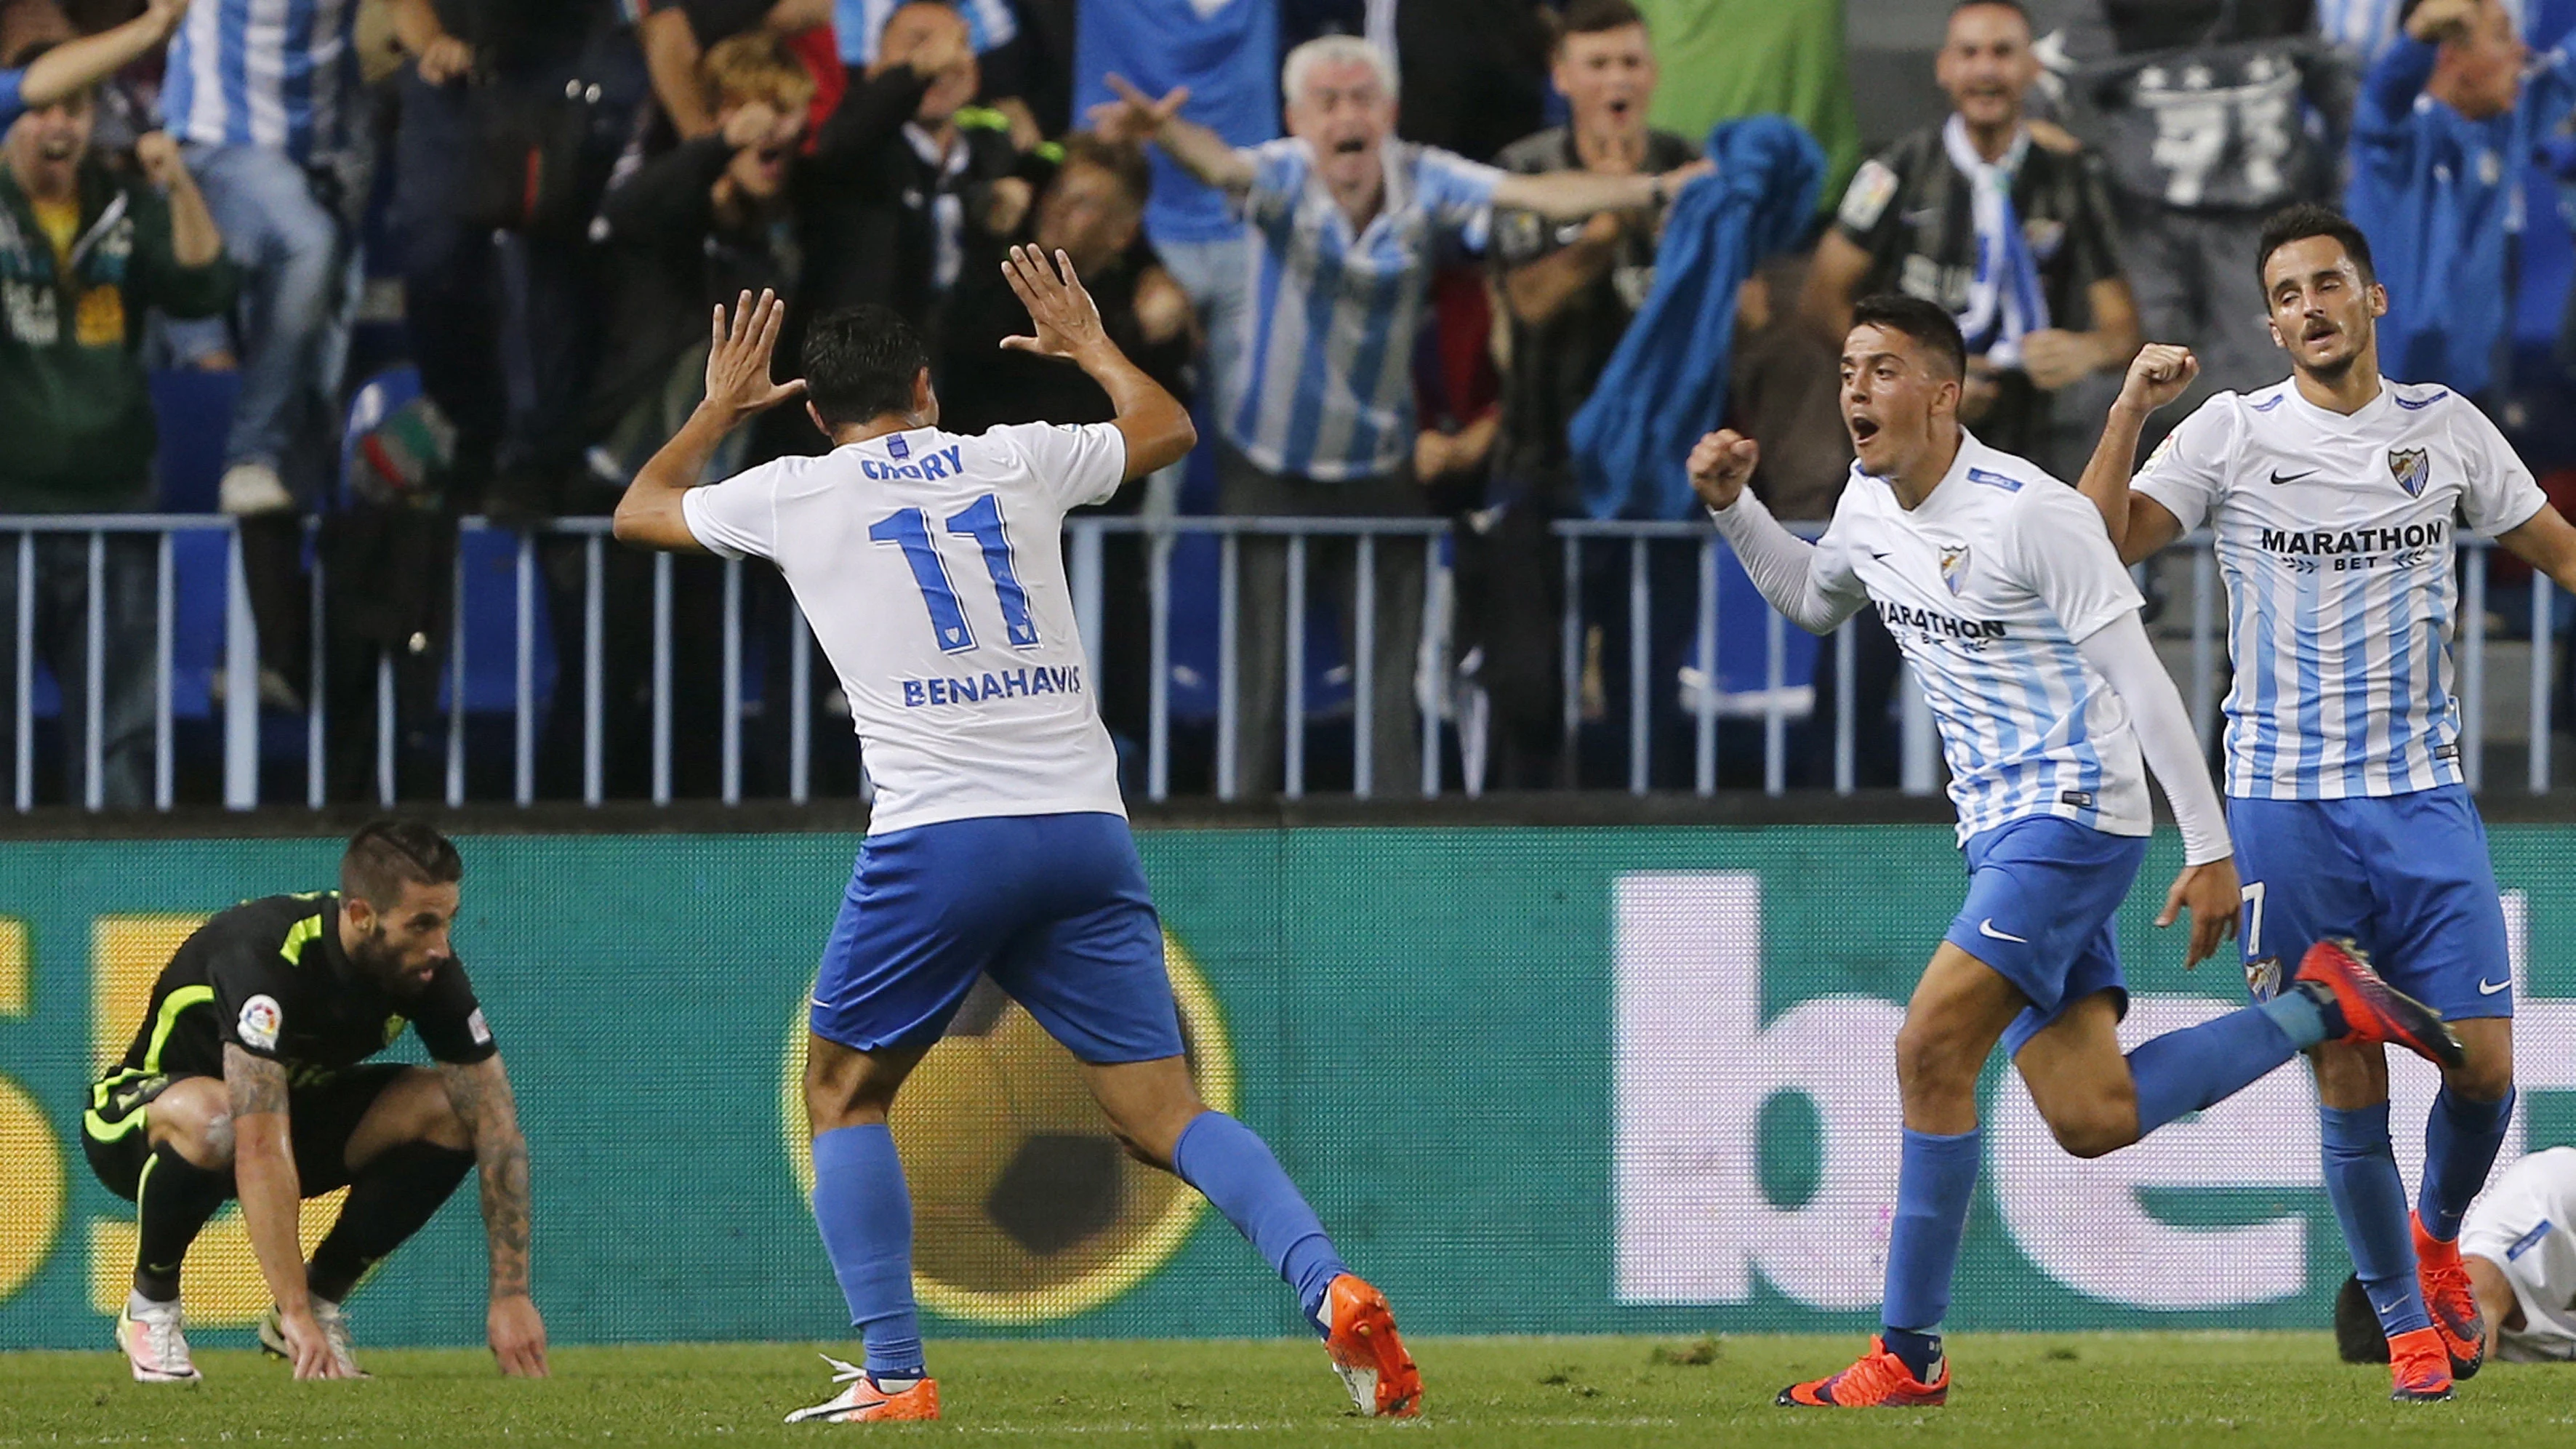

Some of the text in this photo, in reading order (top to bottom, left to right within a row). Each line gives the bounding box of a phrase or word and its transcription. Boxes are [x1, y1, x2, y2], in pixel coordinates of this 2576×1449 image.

[2261, 521, 2441, 555] MARATHON
[868, 494, 1043, 654] 11
[2334, 557, 2378, 571] BET
[902, 665, 1081, 707] BENAHAVIS
[2239, 880, 2266, 957] 7
